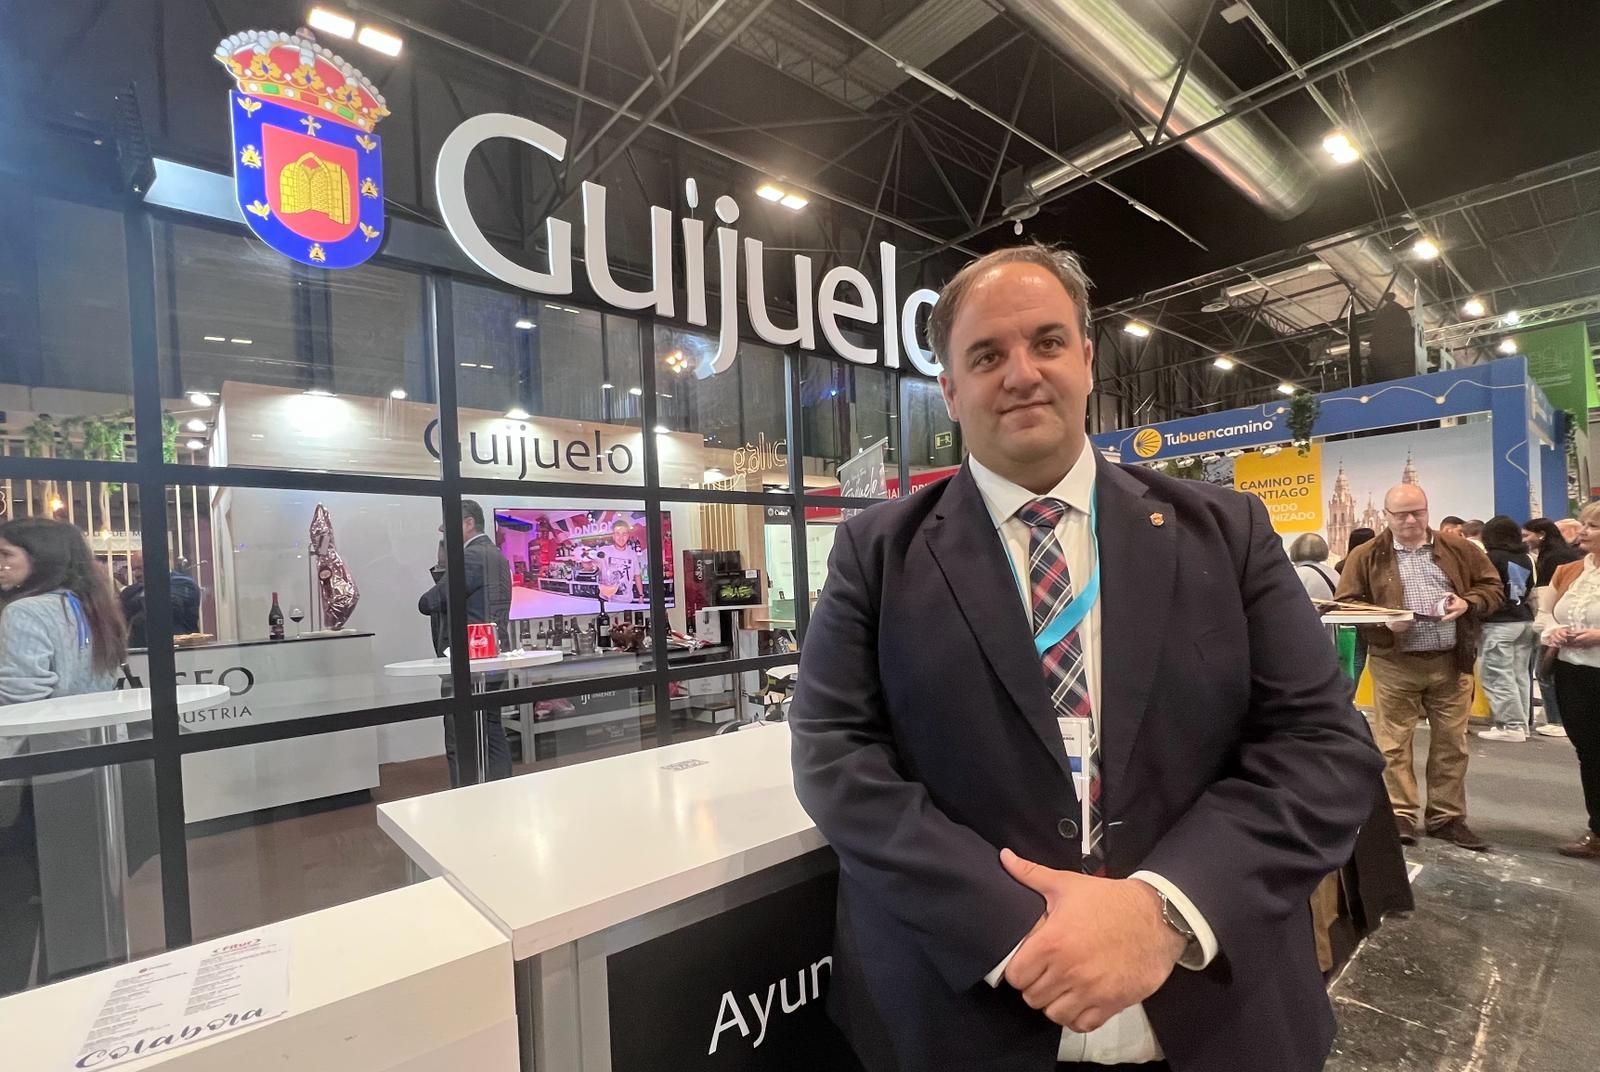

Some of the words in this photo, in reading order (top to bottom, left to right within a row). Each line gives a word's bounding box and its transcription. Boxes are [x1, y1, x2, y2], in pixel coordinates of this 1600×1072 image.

[435, 111, 943, 377] Guijuelo
[1164, 419, 1273, 446] Tubuencamino
[1240, 476, 1292, 490] CAMINO
[1296, 474, 1315, 485] DE
[178, 705, 253, 724] USTRIA
[708, 955, 833, 1056] Ayun
[74, 1007, 264, 1069] Colabora
